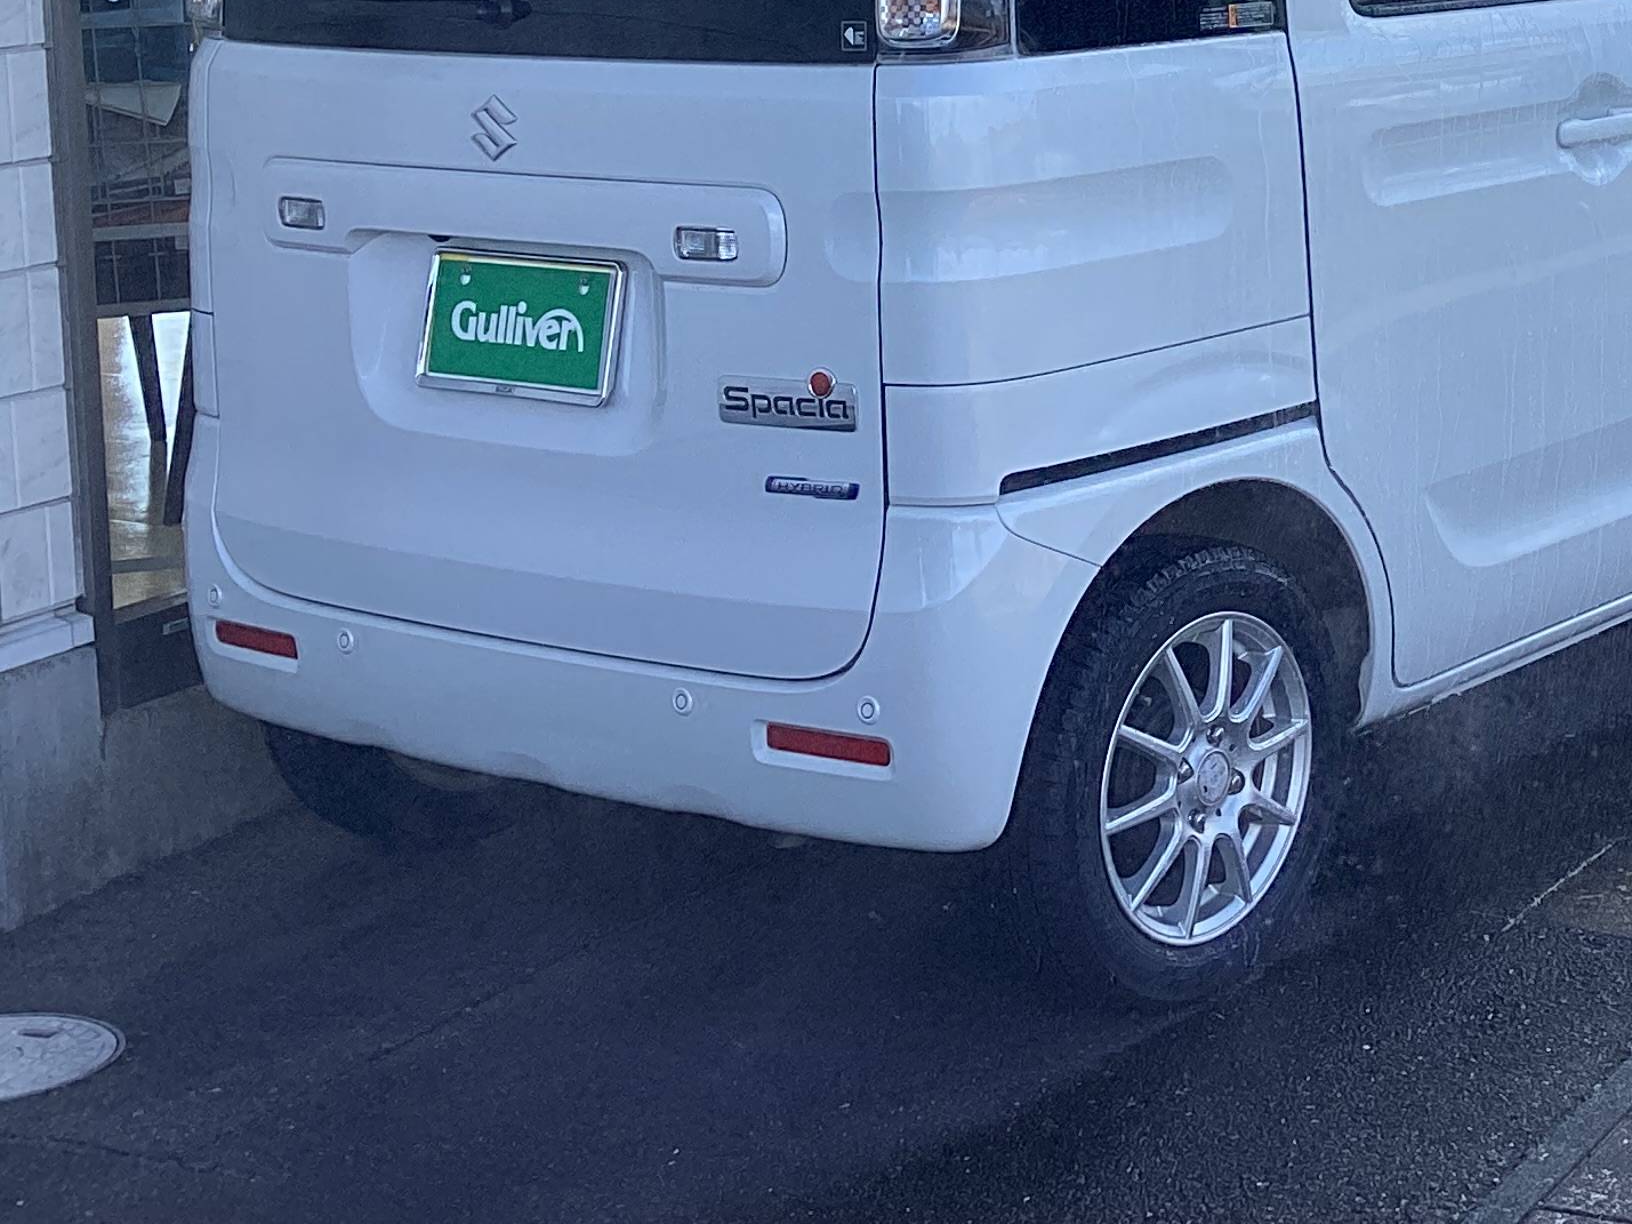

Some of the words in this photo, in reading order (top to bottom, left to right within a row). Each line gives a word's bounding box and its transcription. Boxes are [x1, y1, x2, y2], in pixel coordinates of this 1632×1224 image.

[451, 300, 583, 353] Gulliver
[722, 384, 850, 421] Spacia
[776, 479, 847, 497] HYBRID
